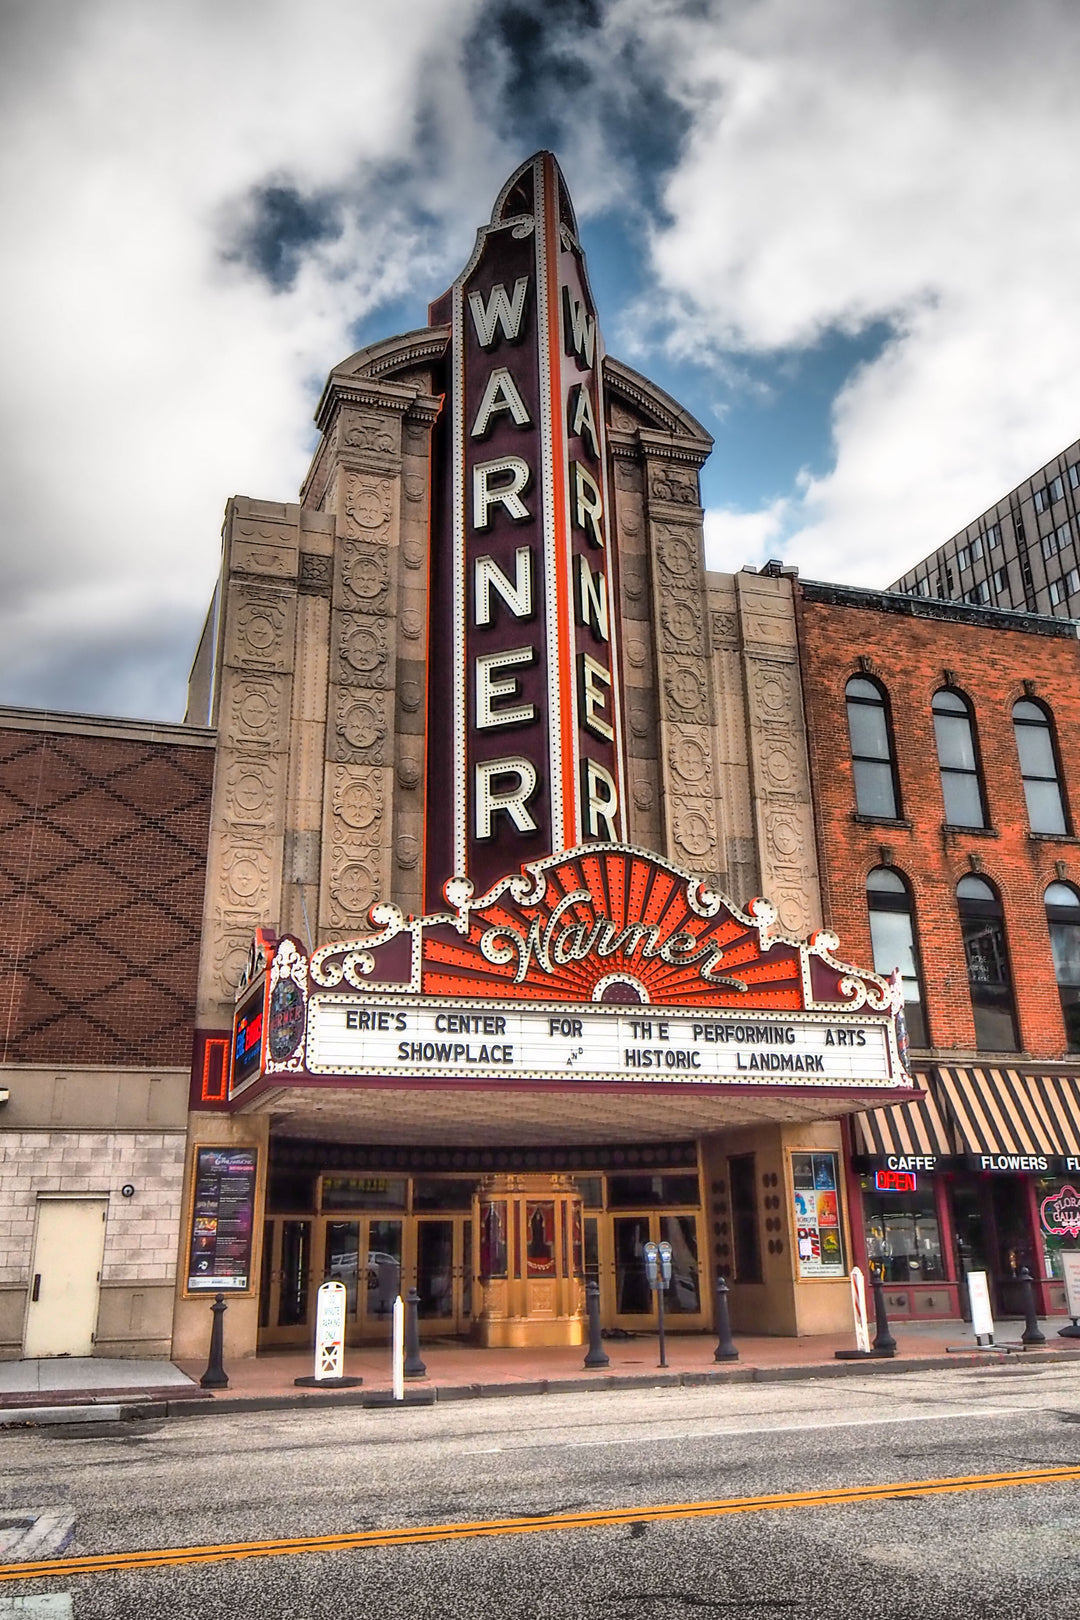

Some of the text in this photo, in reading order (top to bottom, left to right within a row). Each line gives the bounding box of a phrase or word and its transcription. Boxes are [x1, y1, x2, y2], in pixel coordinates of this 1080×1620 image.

[468, 276, 537, 840] WARNER
[562, 284, 616, 843] WARNER
[480, 889, 748, 992] Warner
[346, 1010, 866, 1047] ERIE'S CENTER FOR THE PERFORMING ARTS
[398, 1041, 824, 1071] SHOWPLACE AND HISTORIC LANDMARK
[888, 1156, 936, 1170] CAFFE'
[981, 1156, 1048, 1170] FLOWERS
[877, 1170, 916, 1191] OPEN
